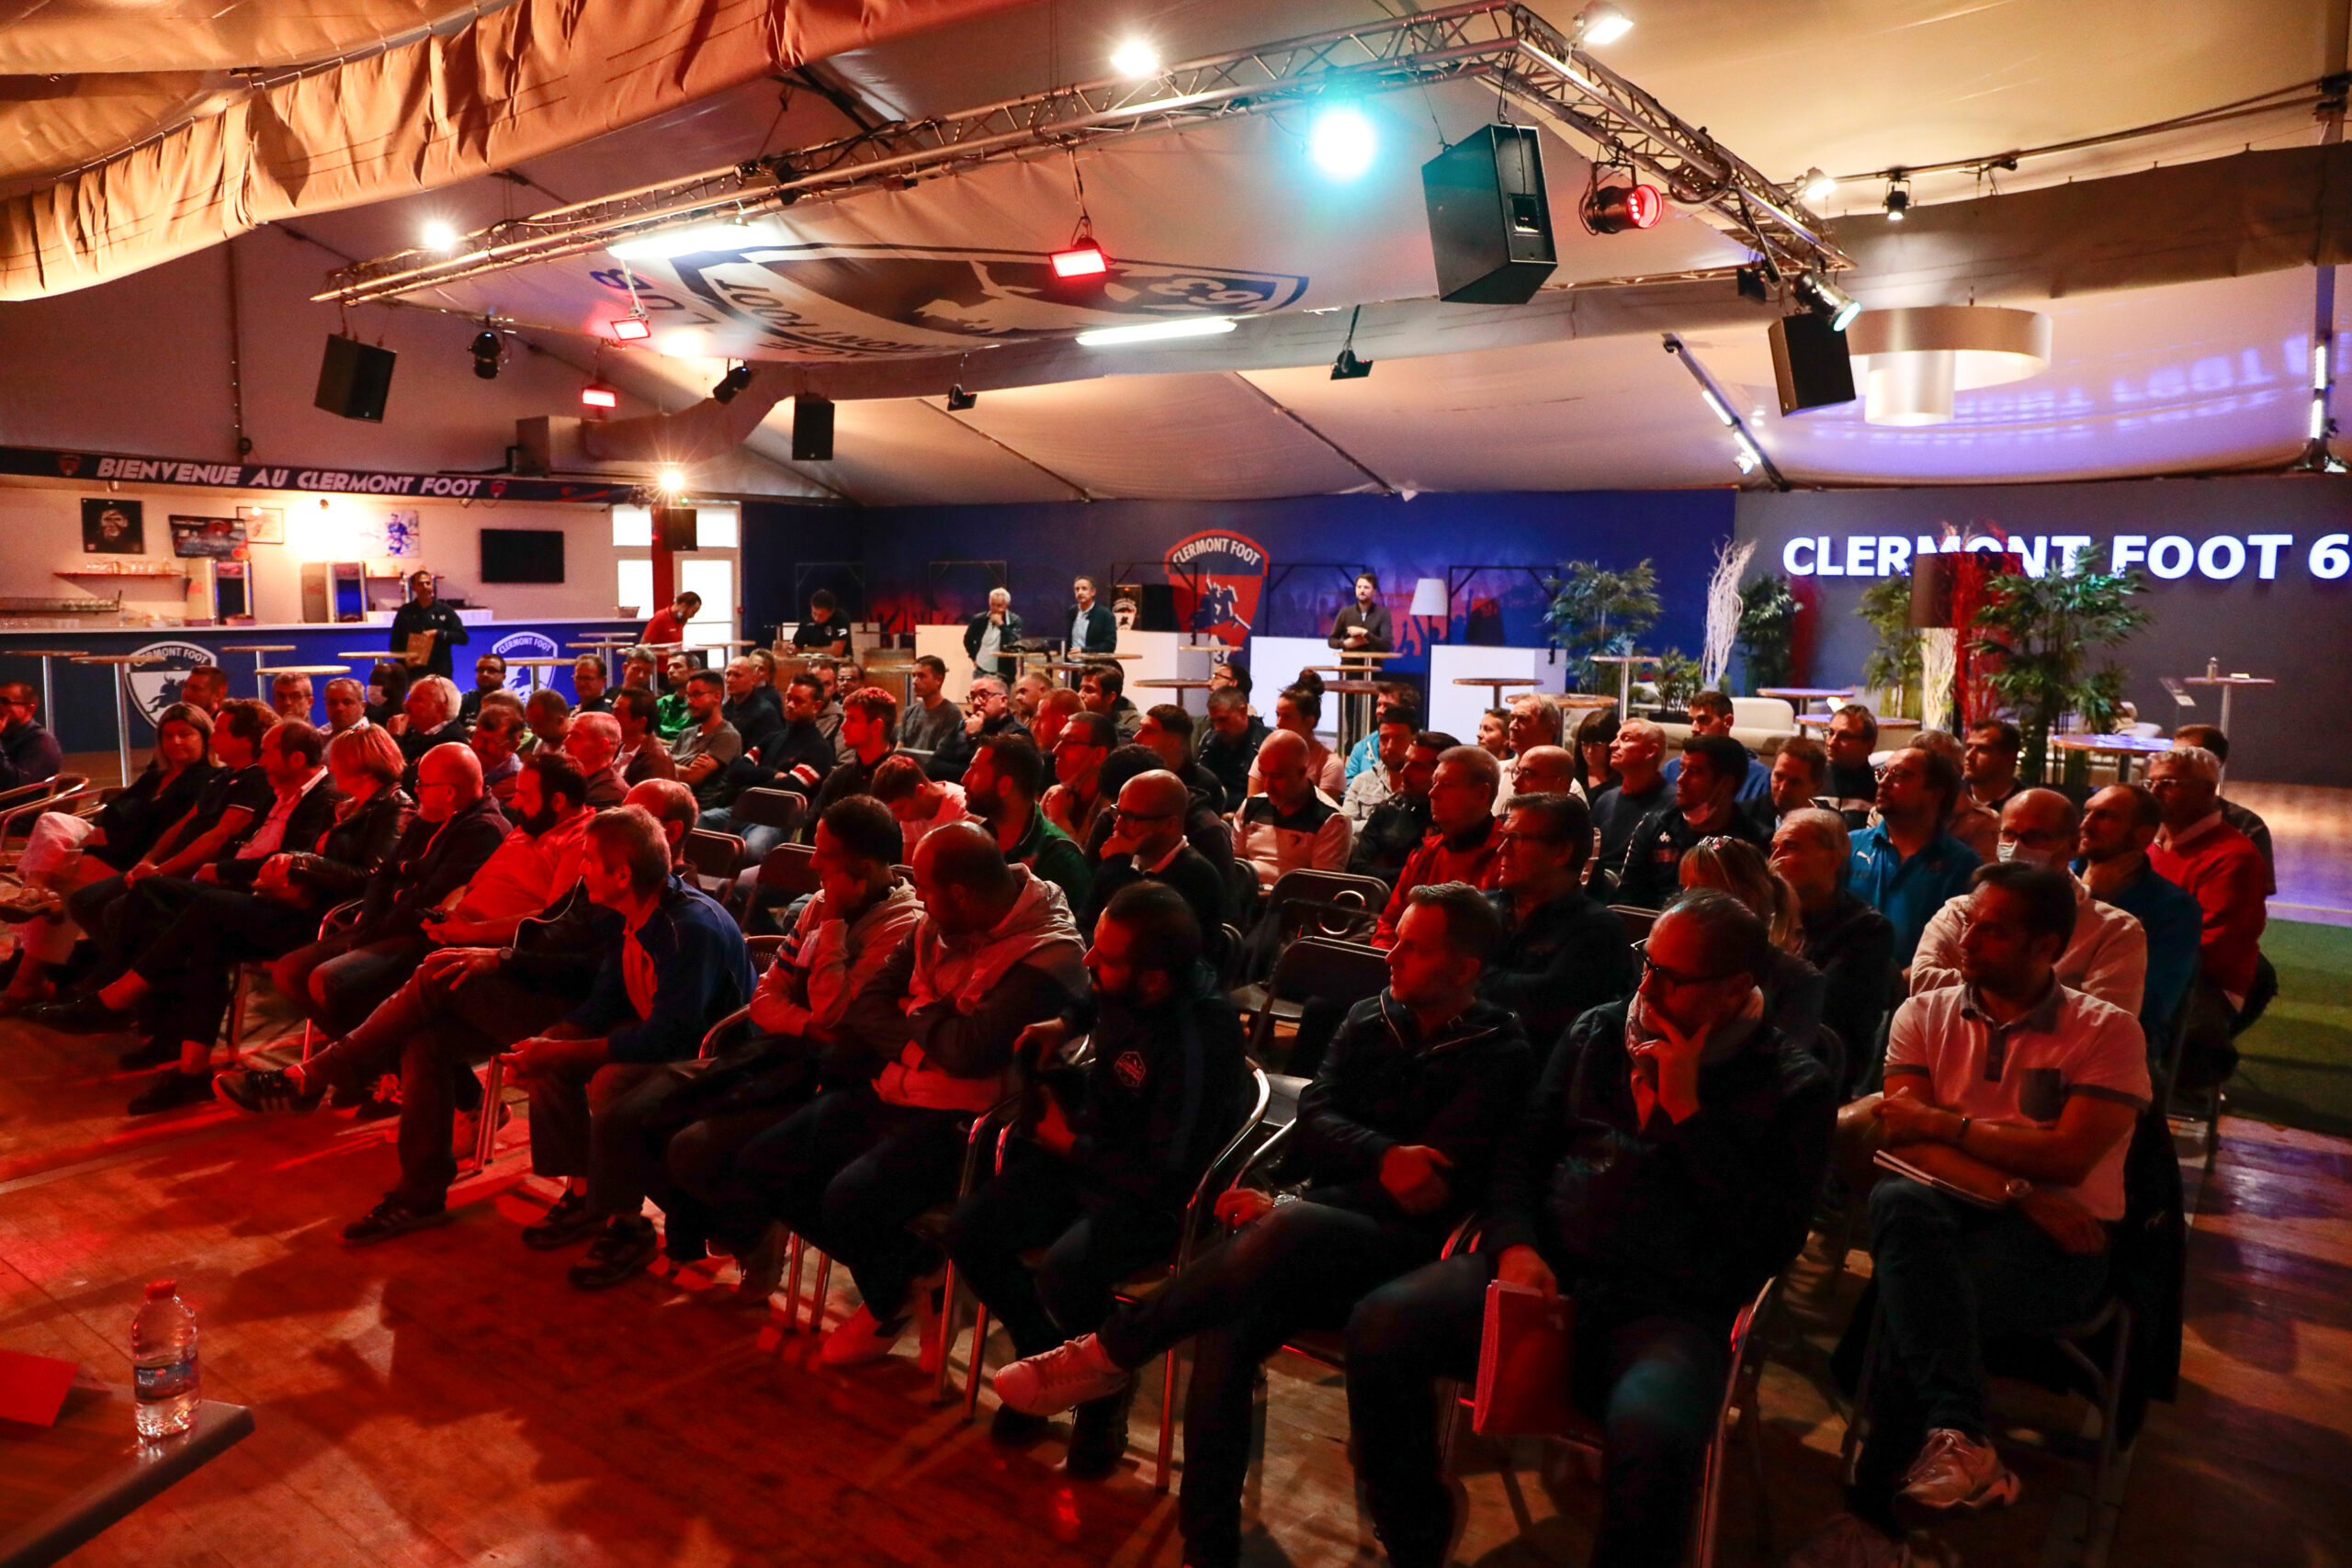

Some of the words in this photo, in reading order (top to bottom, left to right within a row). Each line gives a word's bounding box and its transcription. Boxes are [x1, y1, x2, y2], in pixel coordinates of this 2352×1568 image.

[96, 457, 242, 485] BIENVENUE
[249, 468, 289, 488] AU
[297, 470, 414, 494] CLERMONT
[419, 477, 481, 497] FOOT
[1172, 537, 1229, 564] CLERMONT
[1230, 540, 1261, 566] FOOT
[2111, 535, 2293, 580] FOOT
[184, 649, 209, 663] FOOT
[499, 637, 534, 654] CLERMONT
[534, 639, 551, 652] FOOT
